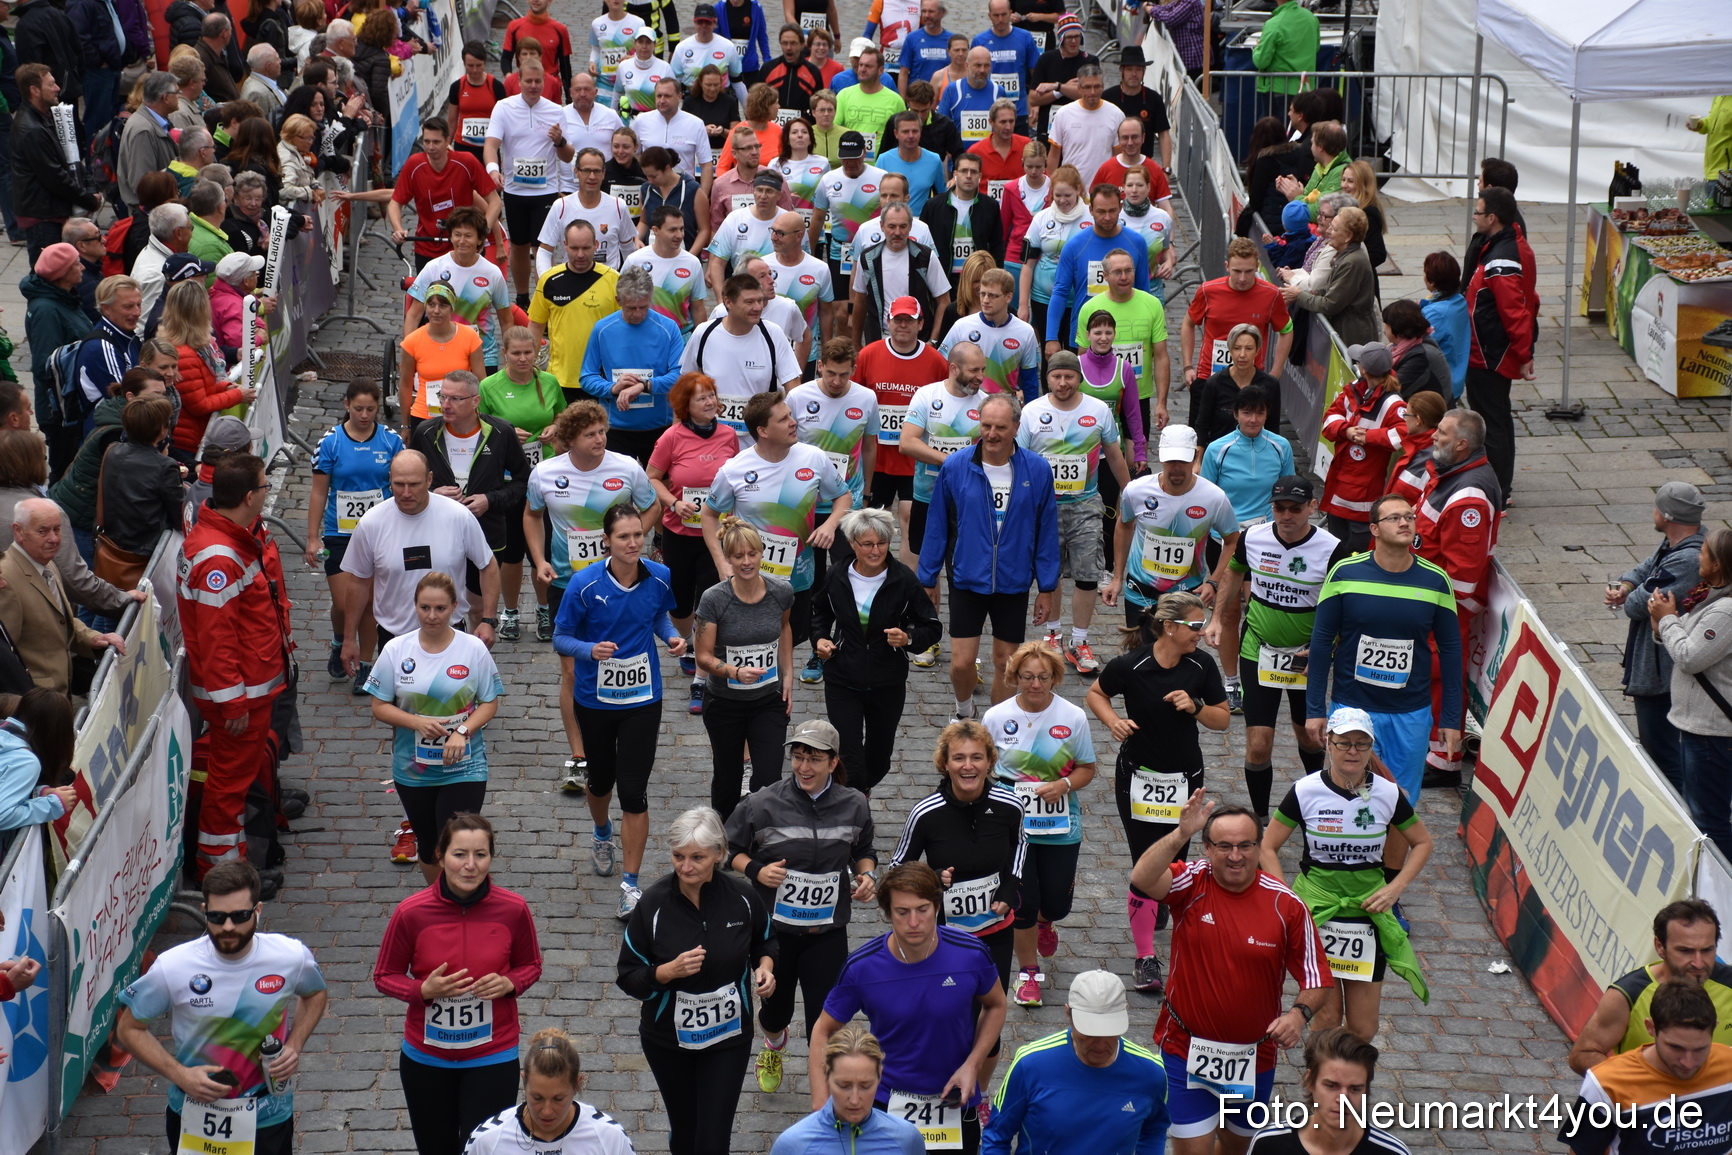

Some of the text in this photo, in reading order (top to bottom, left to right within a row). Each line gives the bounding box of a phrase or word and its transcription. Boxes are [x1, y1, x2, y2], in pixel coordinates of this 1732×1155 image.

[968, 118, 988, 130] 380
[517, 165, 544, 176] 2331
[264, 217, 285, 289] BMW Laufsport
[1052, 464, 1079, 480] 133
[766, 537, 790, 546] Neumarkt
[1154, 546, 1184, 564] 119
[760, 562, 774, 574] Jörg
[1154, 563, 1179, 575] Thomas
[1256, 578, 1310, 596] Laufteam
[1266, 590, 1298, 604] Fürth
[746, 646, 771, 654] Neumarkt
[1360, 640, 1380, 648] PARTL
[618, 660, 642, 669] Neumarkt
[1362, 648, 1408, 670] 2253
[603, 666, 647, 688] 2096
[1270, 673, 1296, 683] Stephan
[1370, 671, 1395, 682] Harald
[612, 689, 638, 698] Kristina
[1142, 784, 1177, 804] 252
[1145, 806, 1172, 818] Angela
[1030, 818, 1056, 828] Monika
[1314, 840, 1381, 852] Laufteam
[966, 880, 993, 893] Neumarkt
[783, 882, 835, 906] 2492
[792, 909, 819, 919] Sabine
[1335, 928, 1366, 936] Neumarkt
[1324, 935, 1364, 959] 279
[678, 992, 728, 1006] PARTL Neumarkt
[431, 1002, 484, 1027] 2151
[682, 1000, 736, 1028] 2513
[438, 1030, 478, 1041] Christine
[690, 1025, 728, 1042] Christine
[1192, 1044, 1247, 1056] PARTL Neumarkt
[1194, 1054, 1250, 1082] 2307
[892, 1090, 916, 1100] PARTL
[210, 1102, 243, 1112] Neumarkt
[904, 1102, 944, 1125] 241
[202, 1112, 232, 1139] 54
[1665, 1120, 1732, 1144] Fischer
[204, 1142, 227, 1155] Marc
[1674, 1134, 1730, 1152] AUTOMOBILE
